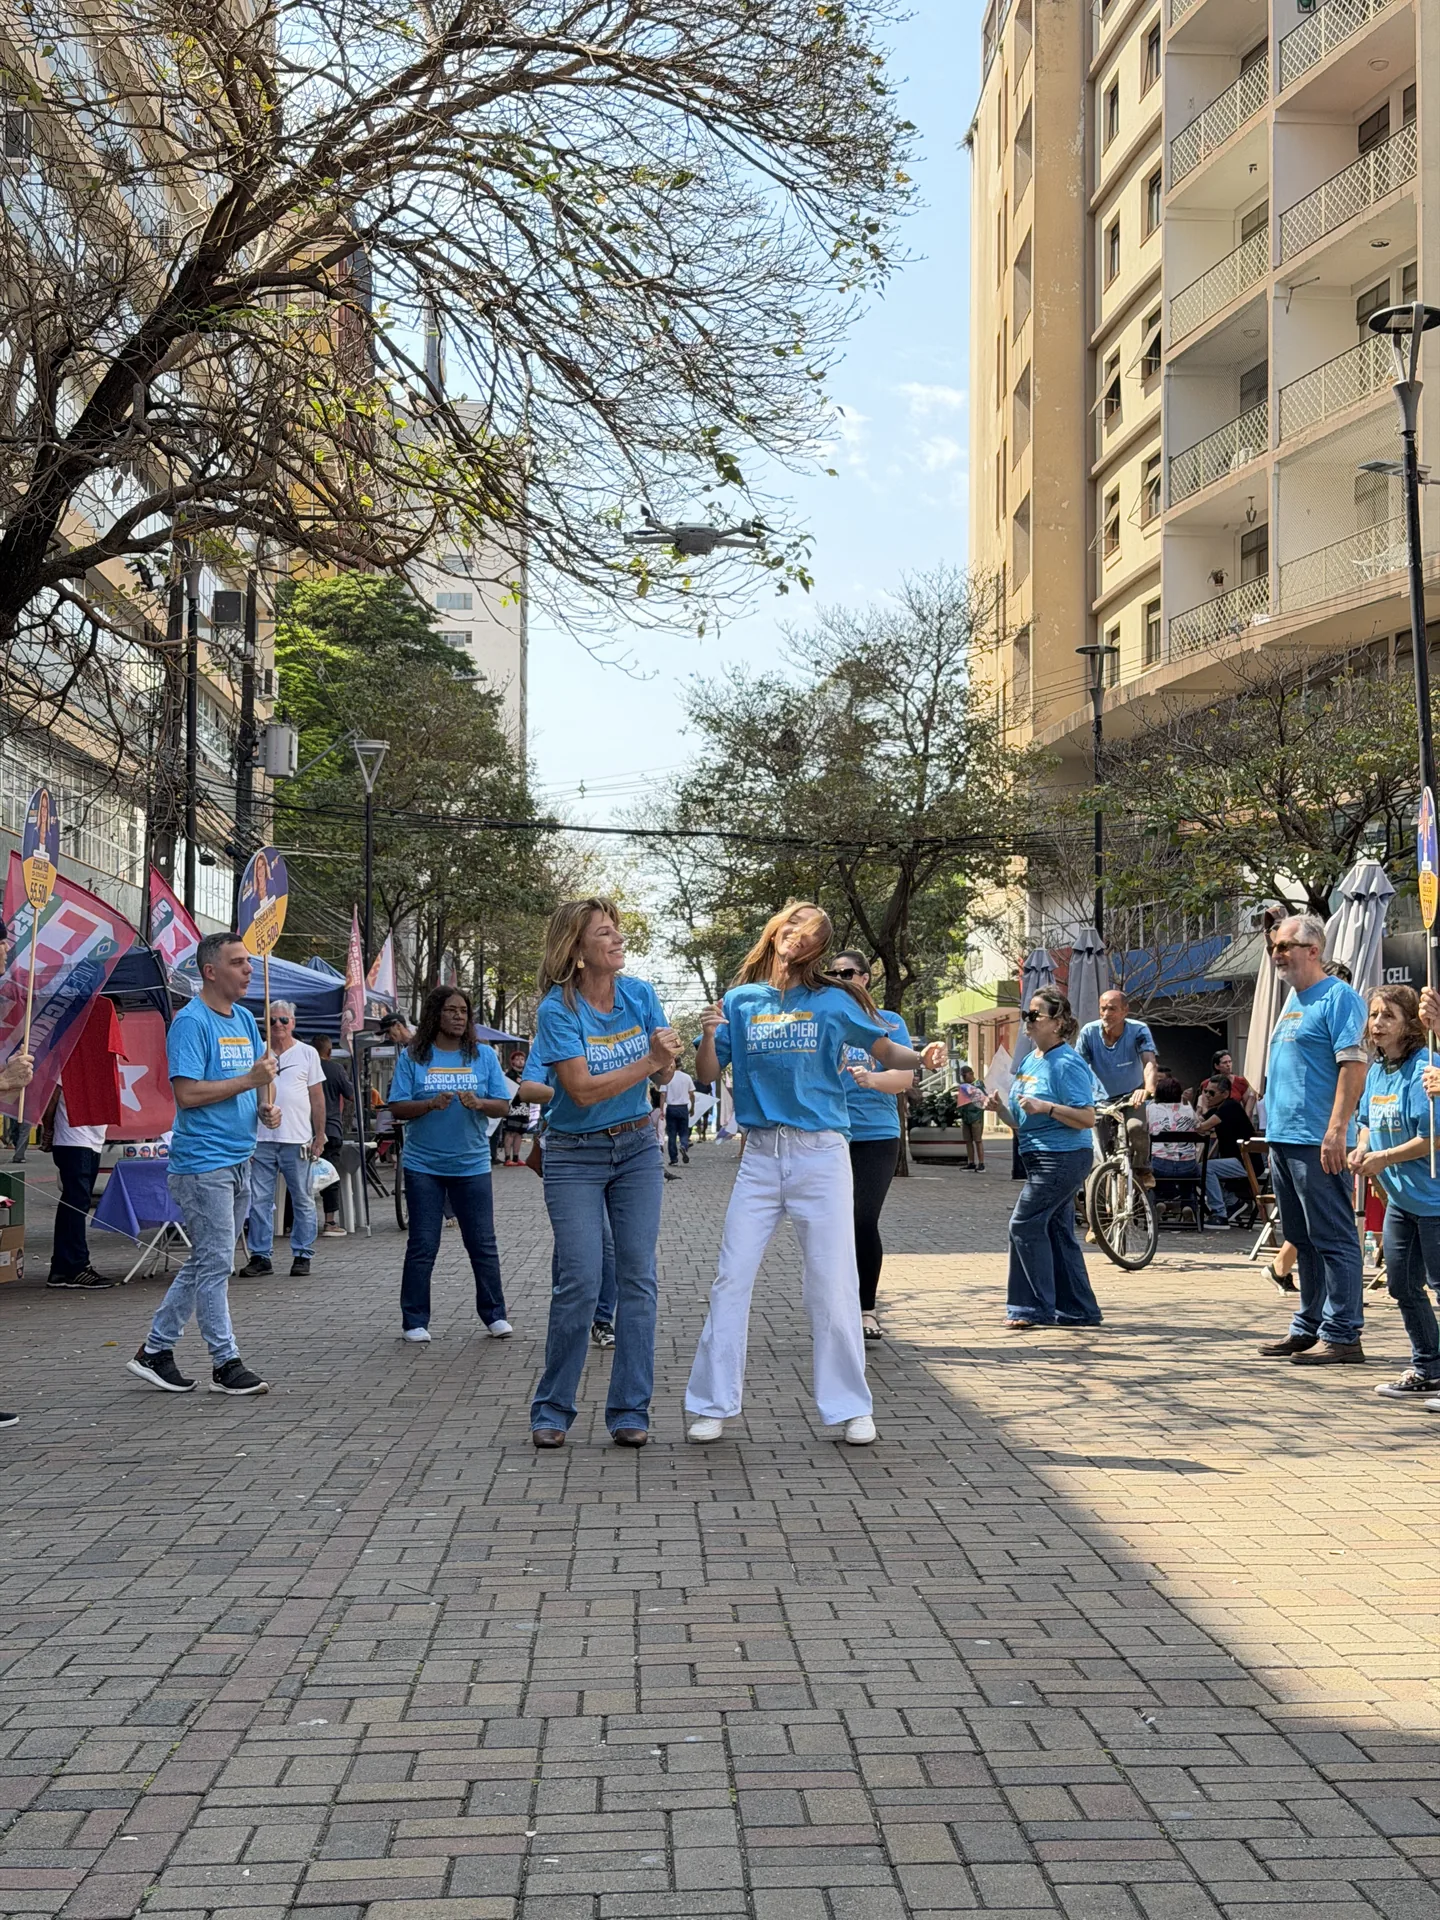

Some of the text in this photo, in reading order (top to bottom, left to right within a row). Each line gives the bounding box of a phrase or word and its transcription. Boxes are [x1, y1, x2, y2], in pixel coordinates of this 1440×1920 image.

[1386, 966, 1413, 984] CELL
[790, 1022, 818, 1038] PIERI
[746, 1038, 818, 1051] DA EDUCAÇÃO
[457, 1073, 478, 1084] PIERI
